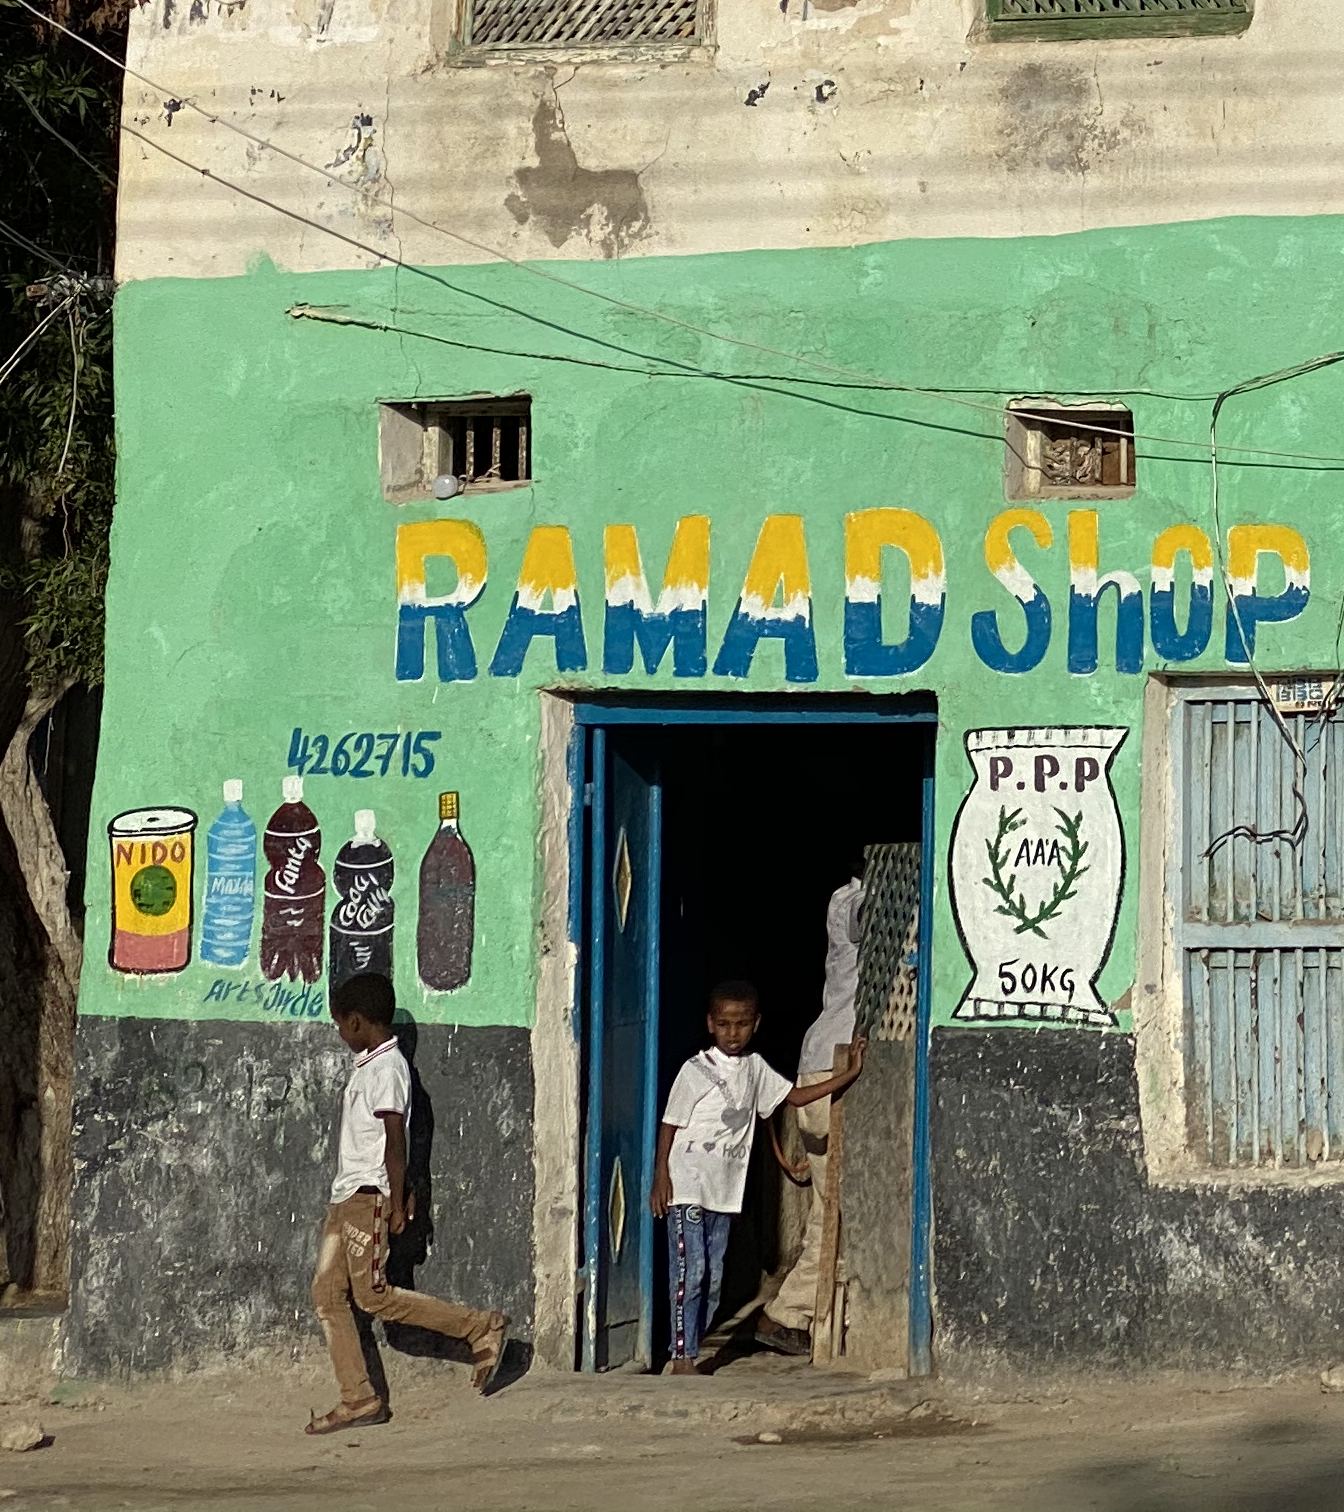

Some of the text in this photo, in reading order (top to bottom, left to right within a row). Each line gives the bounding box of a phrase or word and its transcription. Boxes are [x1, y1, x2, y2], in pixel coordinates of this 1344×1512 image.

[395, 508, 946, 682] RAMAD
[288, 727, 442, 778] 4262715
[115, 841, 186, 867] NIDO
[998, 958, 1075, 1003] 50KG
